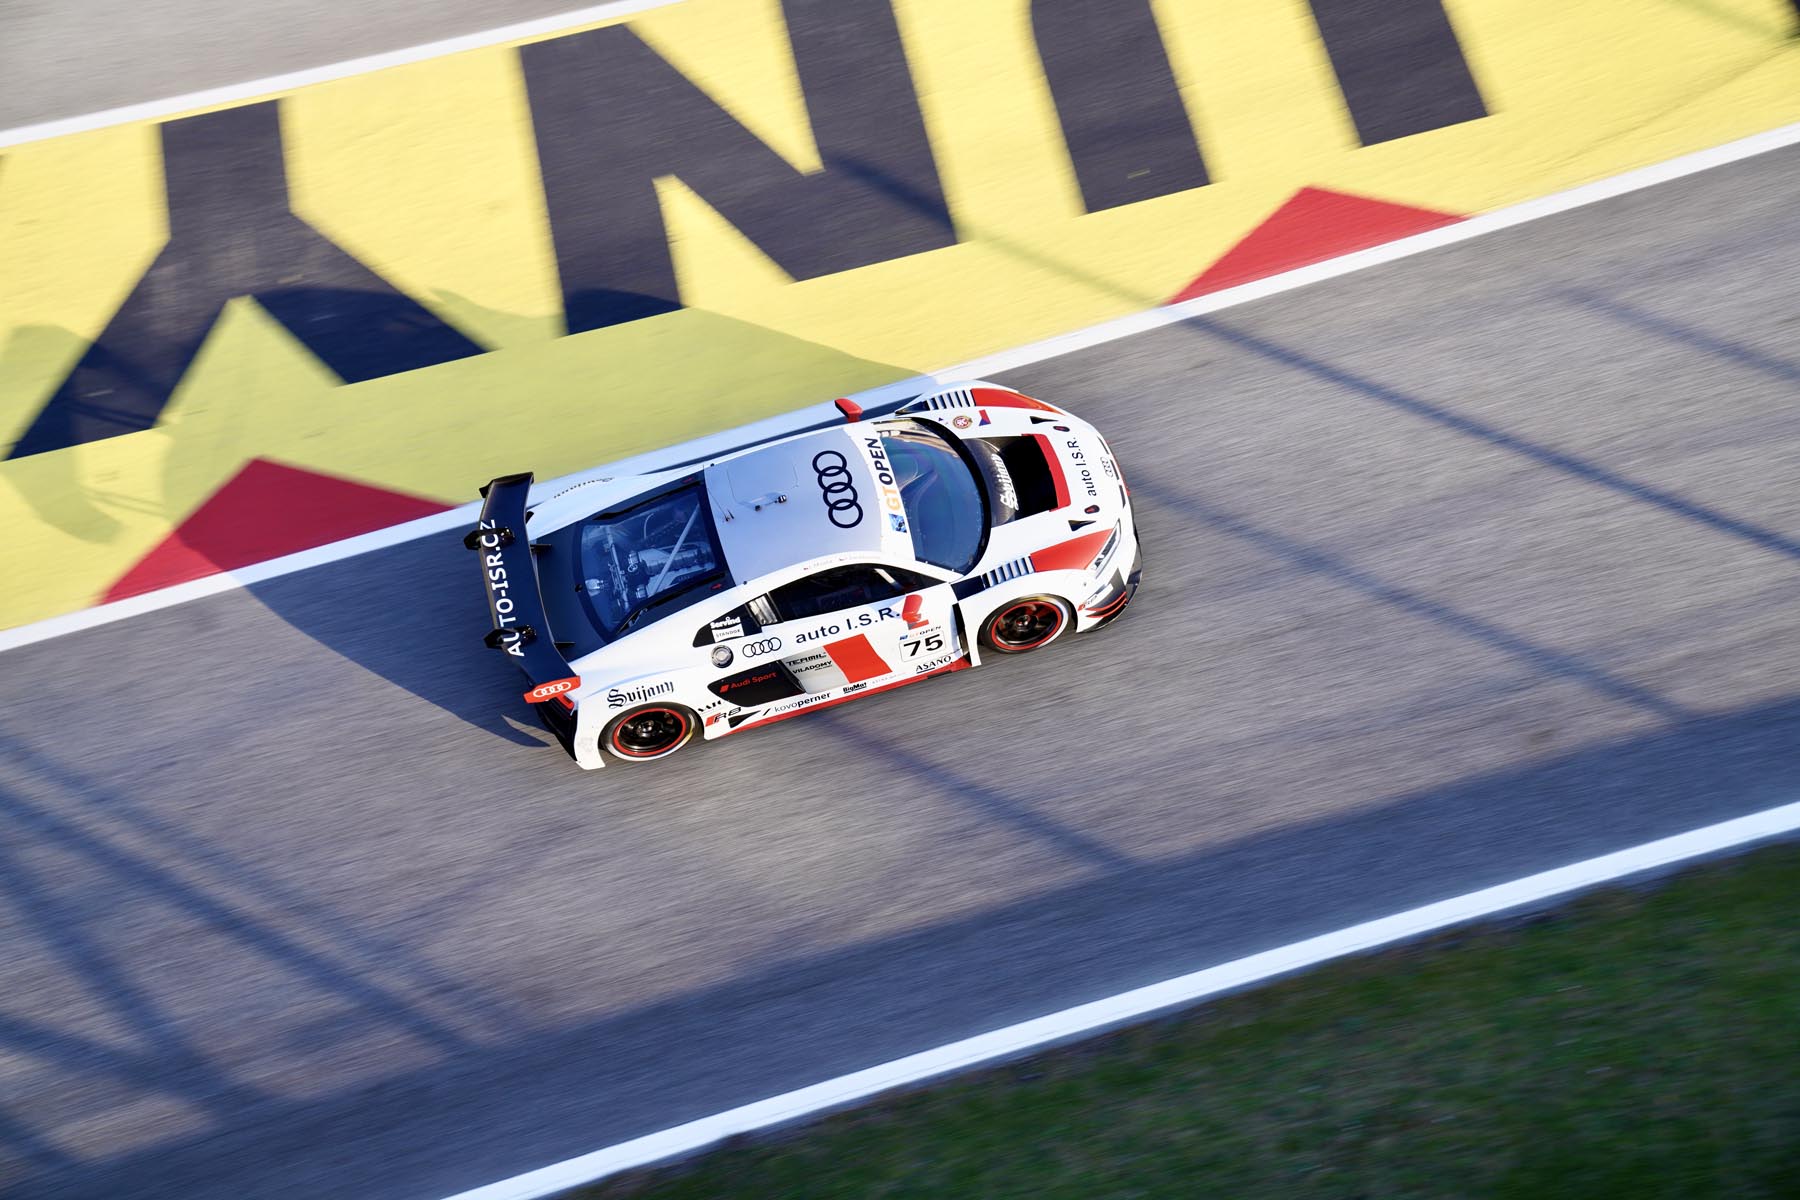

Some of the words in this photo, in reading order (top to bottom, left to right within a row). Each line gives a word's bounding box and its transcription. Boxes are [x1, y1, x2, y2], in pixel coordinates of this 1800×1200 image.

[863, 437, 894, 486] OPEN
[1066, 436, 1087, 467] I.S.R.
[1080, 469, 1098, 497] auto
[882, 485, 901, 511] GT
[479, 519, 526, 658] AUTO-ISR.CZ
[795, 625, 841, 644] auto
[846, 607, 901, 630] I.S.R.
[919, 625, 942, 636] OPEN
[903, 633, 944, 657] 75
[791, 660, 832, 674] VILADOMY
[915, 655, 952, 673] ASANO
[730, 679, 751, 689] Audi
[751, 671, 777, 684] Sport
[842, 682, 867, 693] BigMat
[774, 691, 831, 713] kovoperner
[712, 706, 742, 724] R8
